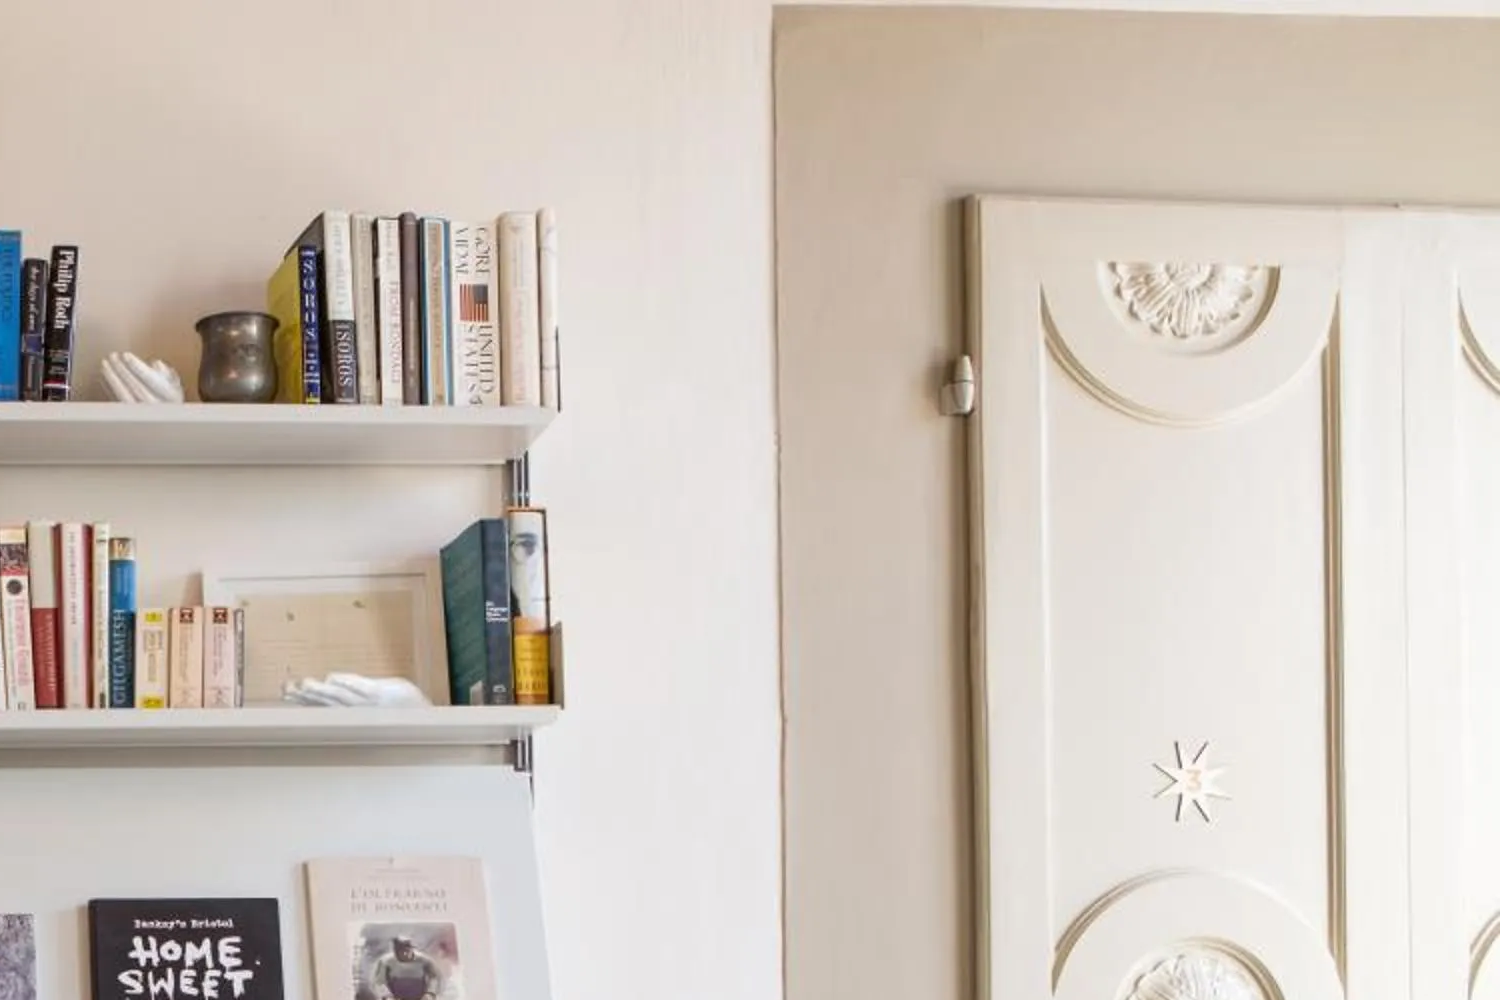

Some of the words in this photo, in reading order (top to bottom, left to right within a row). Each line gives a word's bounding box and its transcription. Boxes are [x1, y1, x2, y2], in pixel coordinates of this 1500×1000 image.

[53, 249, 76, 295] Philip
[475, 227, 492, 279] GORE
[53, 298, 72, 330] Roth
[338, 331, 355, 388] SOROS
[480, 325, 495, 395] UNITED
[112, 609, 128, 704] GILGAMESH
[134, 919, 187, 930] Banksy's
[191, 918, 234, 929] Bristol
[129, 936, 243, 968] HOME
